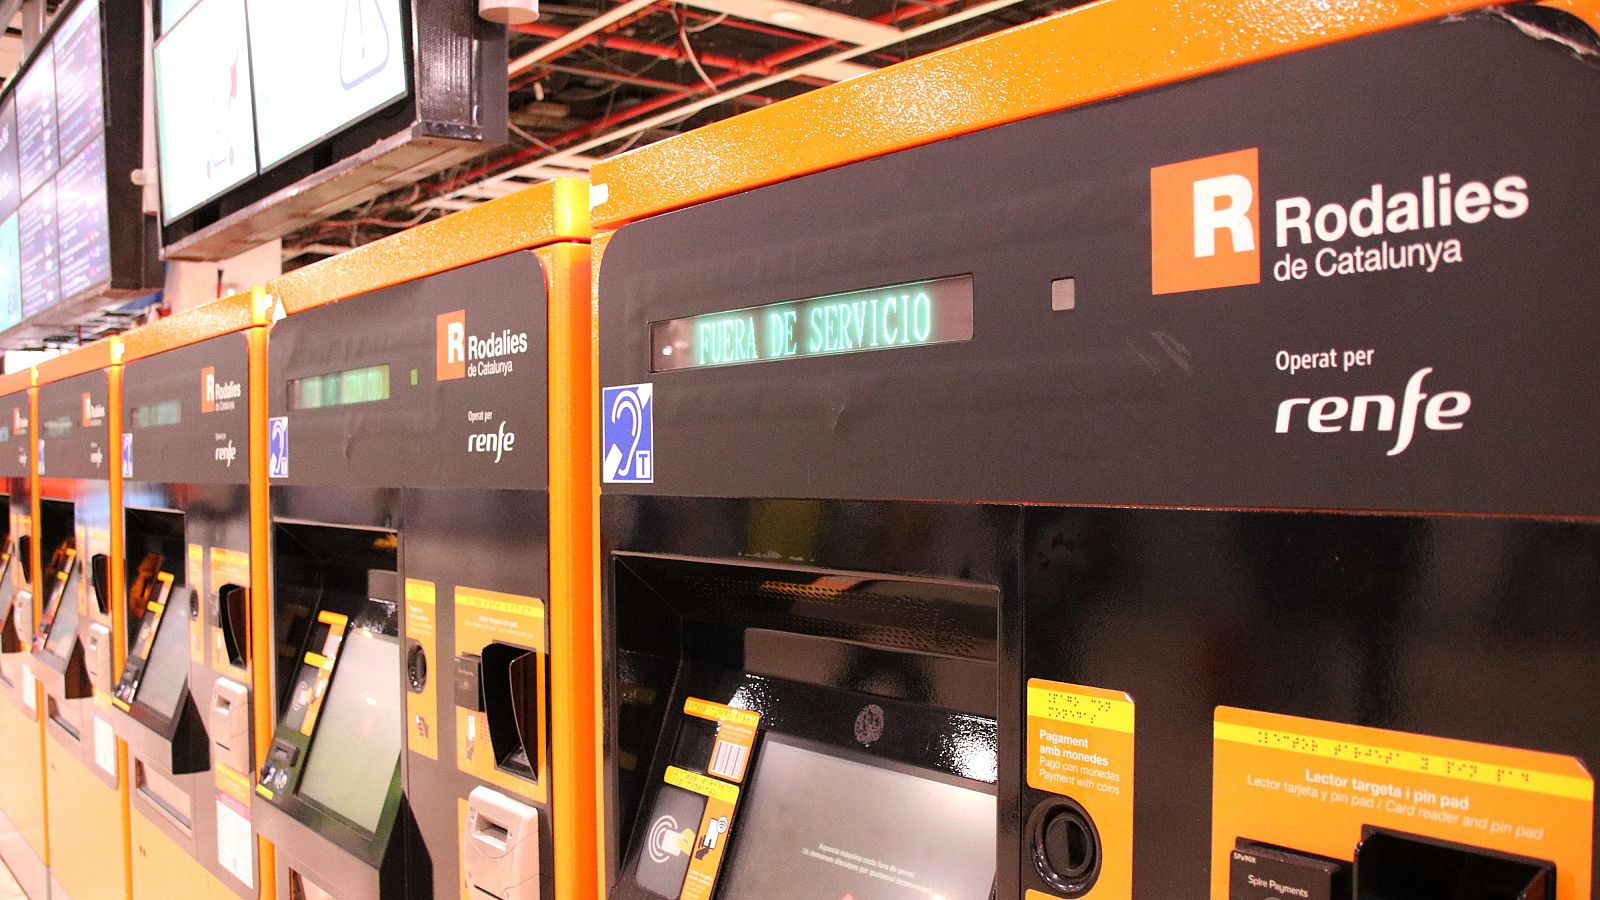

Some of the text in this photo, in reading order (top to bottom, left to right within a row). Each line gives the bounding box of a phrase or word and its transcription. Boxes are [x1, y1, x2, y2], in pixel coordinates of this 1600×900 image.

[1193, 173, 1255, 258] R
[1275, 172, 1530, 248] Rodalies
[1273, 238, 1463, 282] de Catalunya
[447, 321, 465, 364] R
[699, 292, 932, 365] FUERA DE SERVICIO
[468, 328, 528, 361] Rodalies
[467, 359, 514, 378] de Catalunya
[1275, 348, 1375, 375] Operat per
[467, 410, 493, 423] Operat per
[1274, 366, 1472, 457] renfe
[215, 439, 237, 468] renfe
[467, 420, 515, 464] renfe
[638, 453, 648, 476] T
[1039, 729, 1089, 748] Pagament
[1039, 744, 1109, 767] amb monedes
[1039, 756, 1121, 783] Pago con monedas
[1039, 768, 1121, 795] Payment with coins
[1305, 768, 1470, 811] Lector targeta i pin pad
[1247, 774, 1281, 791] Lector
[1283, 782, 1319, 798] tarjeta
[1320, 788, 1328, 801] y
[1330, 791, 1349, 804] pin
[1351, 796, 1375, 810] pad
[1385, 799, 1416, 817] Card
[1418, 806, 1460, 825] reader
[1462, 814, 1489, 830] and
[1490, 820, 1513, 836] pin
[1515, 826, 1545, 841] pad
[1247, 874, 1309, 898] Spire Payments
